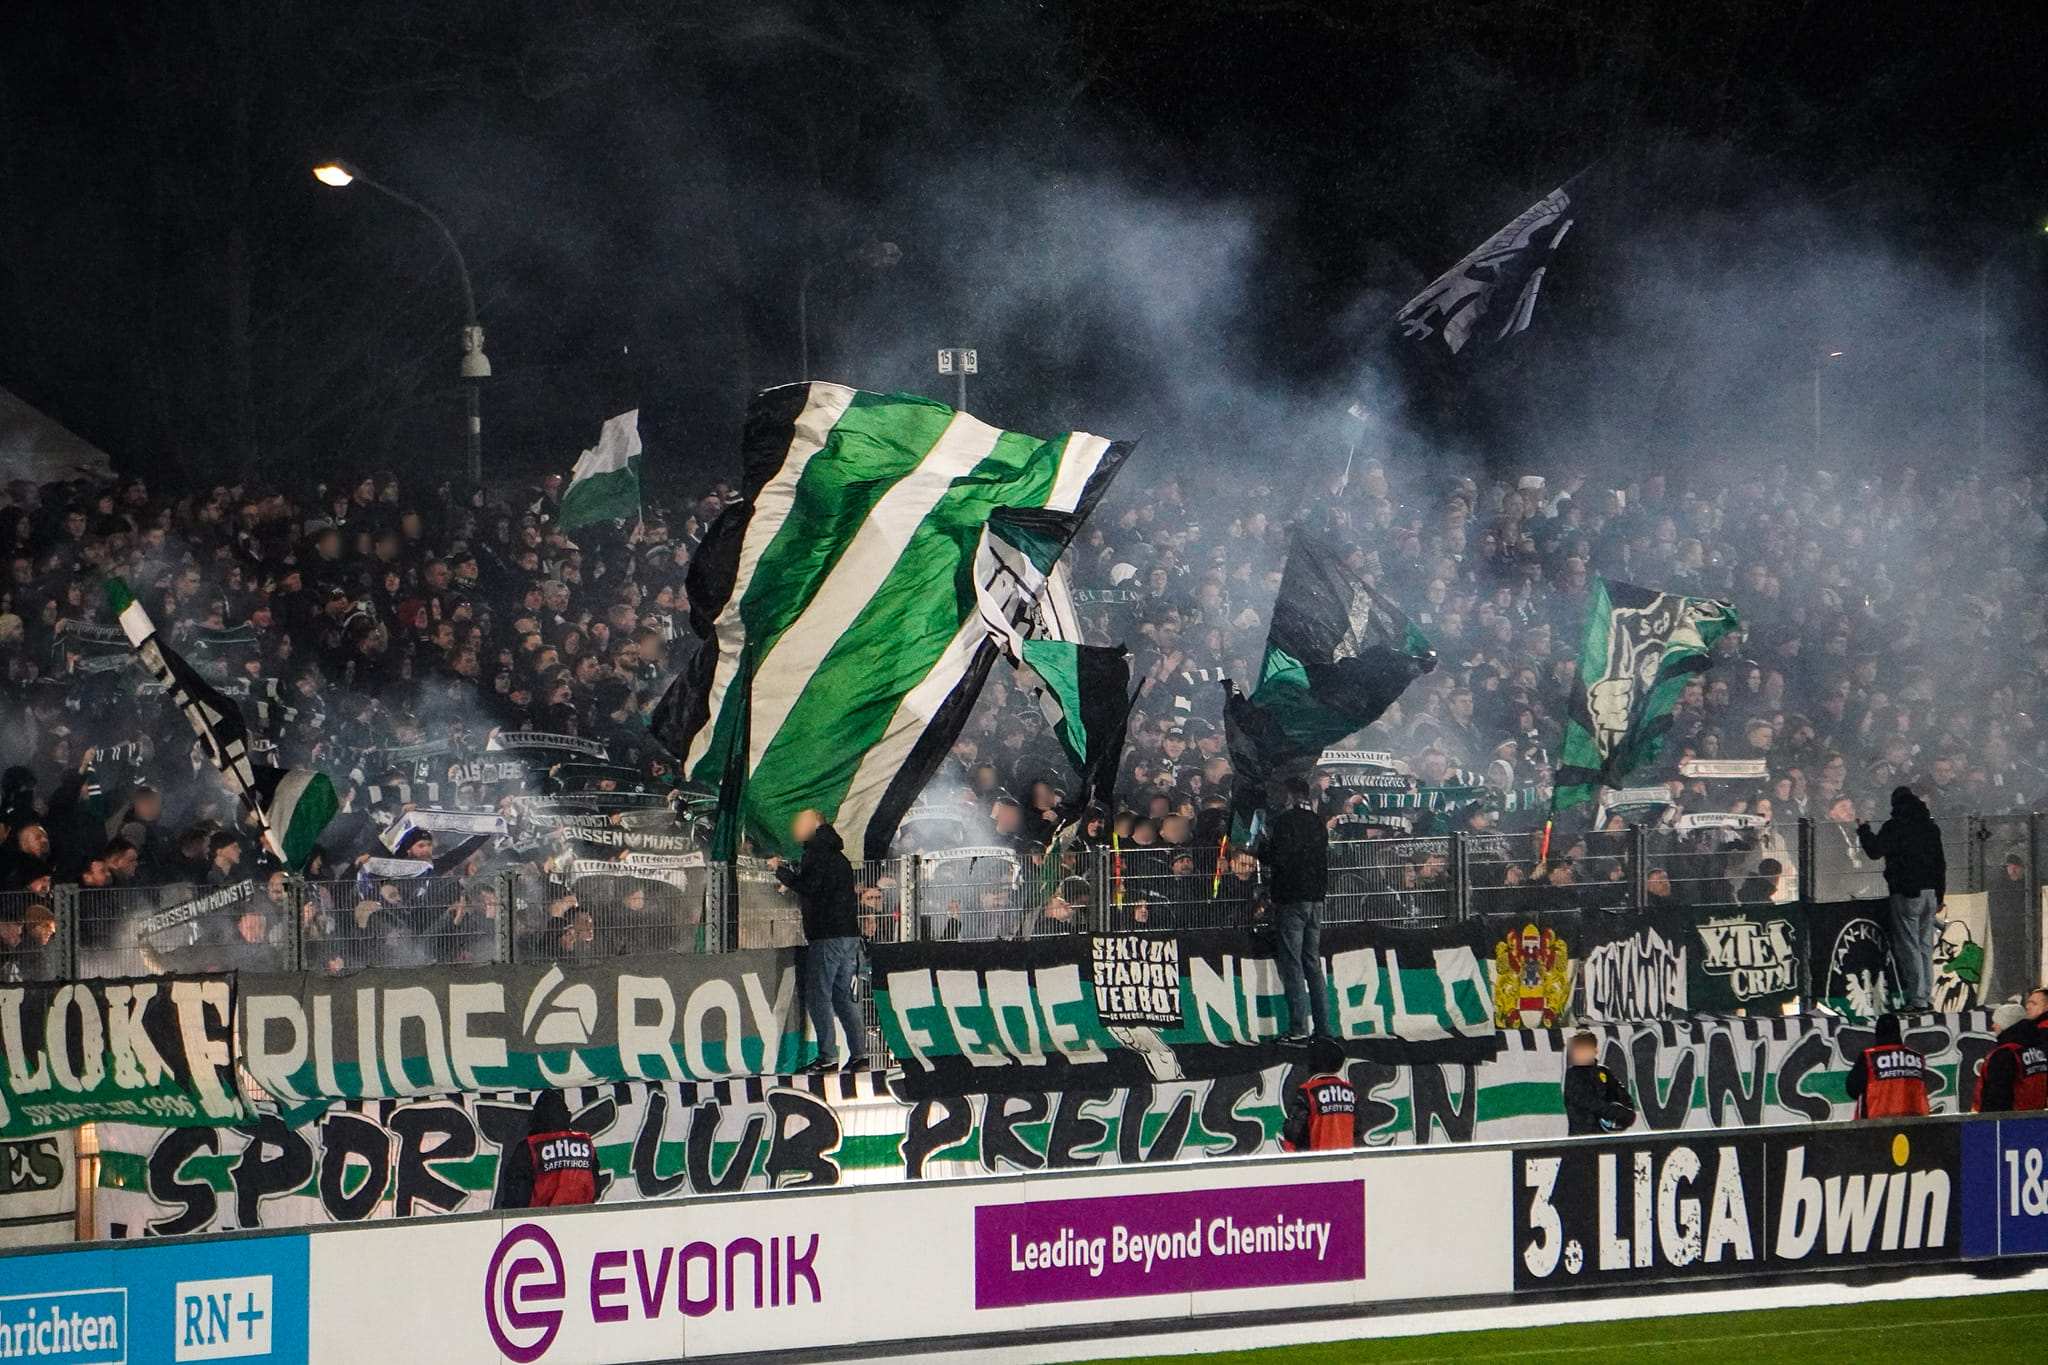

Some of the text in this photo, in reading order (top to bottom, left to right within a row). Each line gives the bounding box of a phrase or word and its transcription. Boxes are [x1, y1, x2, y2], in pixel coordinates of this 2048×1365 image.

[941, 352, 949, 365] 15
[966, 352, 975, 365] 16
[1092, 936, 1178, 962] SEKTION
[1093, 961, 1180, 987] STADION
[1095, 986, 1180, 1014] VERBOT
[1877, 1051, 1922, 1069] atlas
[541, 1140, 589, 1160] atlas
[1775, 1133, 1952, 1260] bwin
[1524, 1146, 1755, 1278] 3. LIGA
[1011, 1215, 1331, 1276] Leading Beyond Chemistry
[590, 1233, 822, 1323] EVONIK
[184, 1292, 264, 1347] RN+
